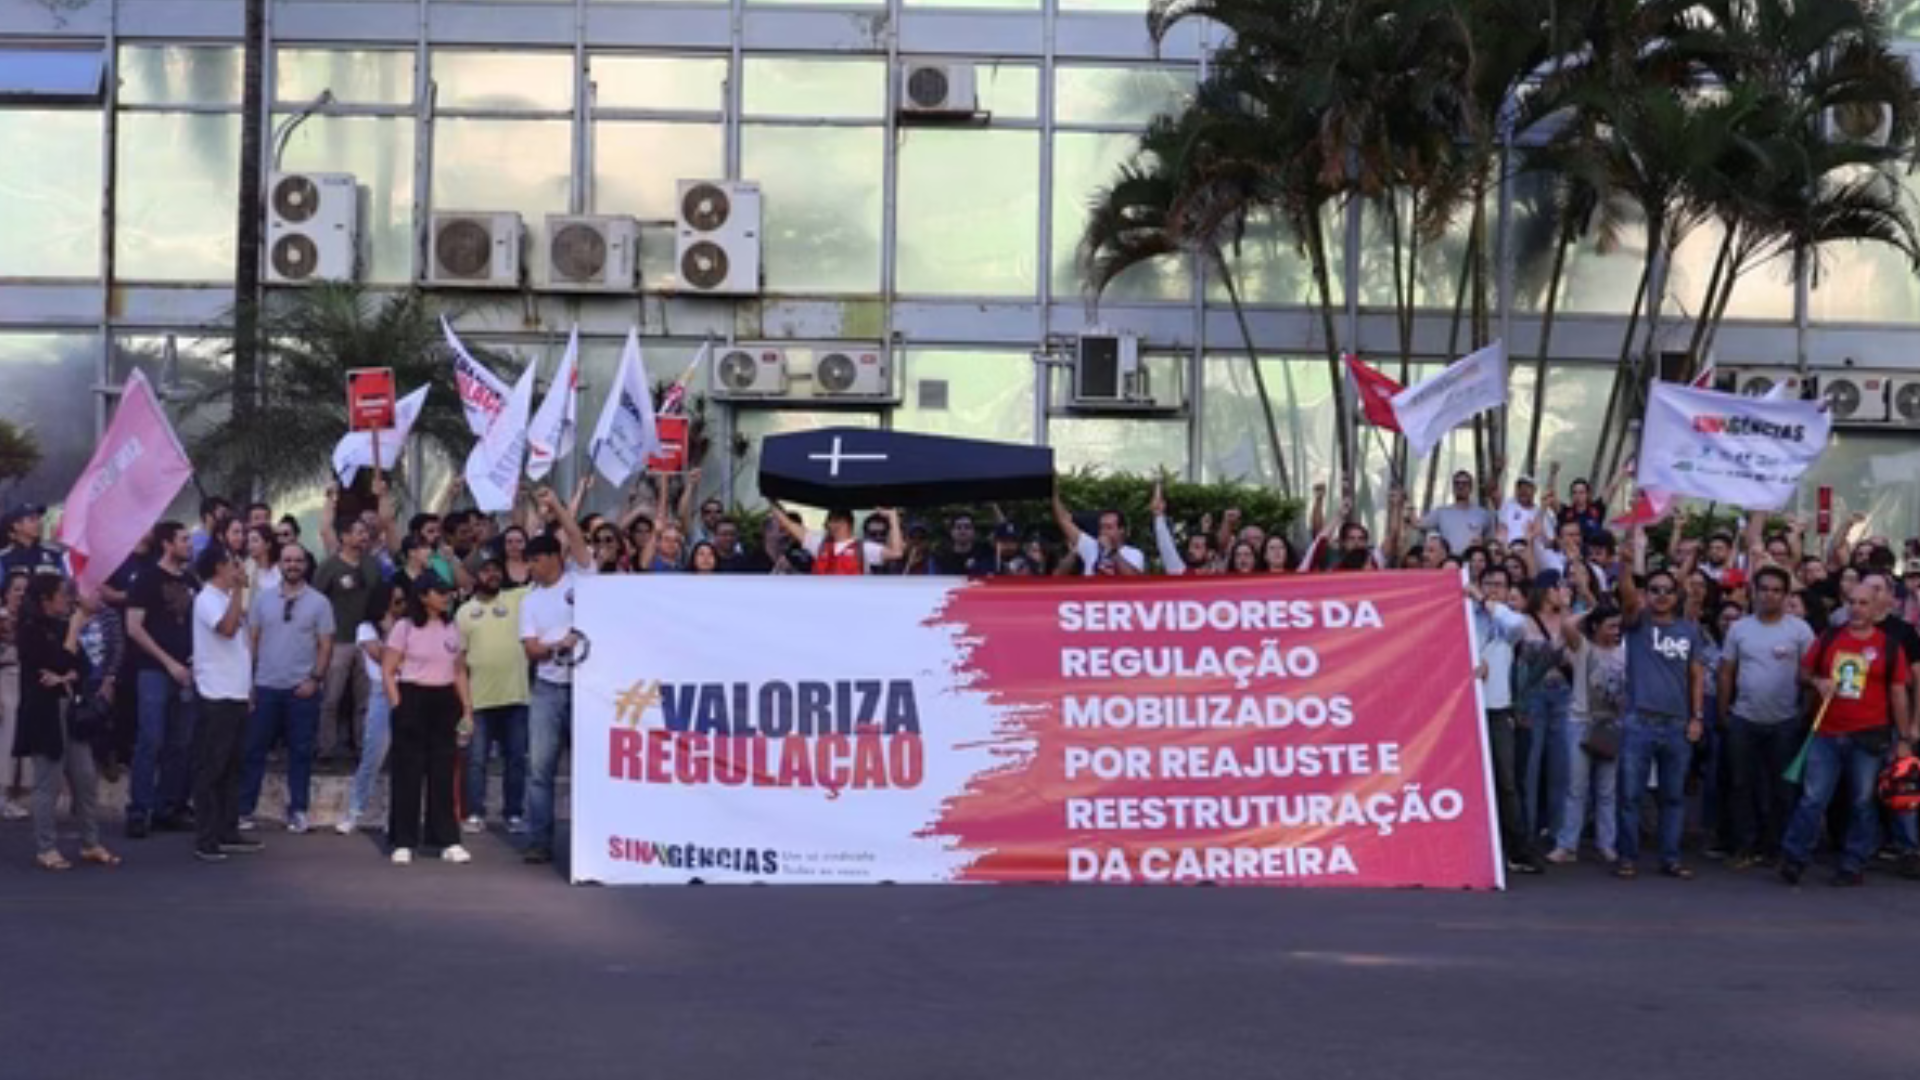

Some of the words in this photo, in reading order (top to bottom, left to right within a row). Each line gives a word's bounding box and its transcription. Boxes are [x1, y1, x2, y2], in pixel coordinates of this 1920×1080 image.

[1058, 599, 1314, 632] SERVIDORES
[1319, 599, 1385, 629] DA
[1653, 627, 1690, 660] Lee
[1061, 638, 1320, 690] REGULAÇÃO
[614, 679, 921, 738] #VALORIZA
[1061, 694, 1354, 730] MOBILIZADOS
[609, 723, 924, 800] REGULAÇÃO
[1064, 746, 1152, 780] POR
[1159, 744, 1371, 778] REAJUSTE
[1377, 743, 1403, 775] E
[1066, 784, 1464, 836] REESTRUTURAÇÃO
[1068, 848, 1132, 882] DA
[1139, 844, 1359, 880] CARREIRA
